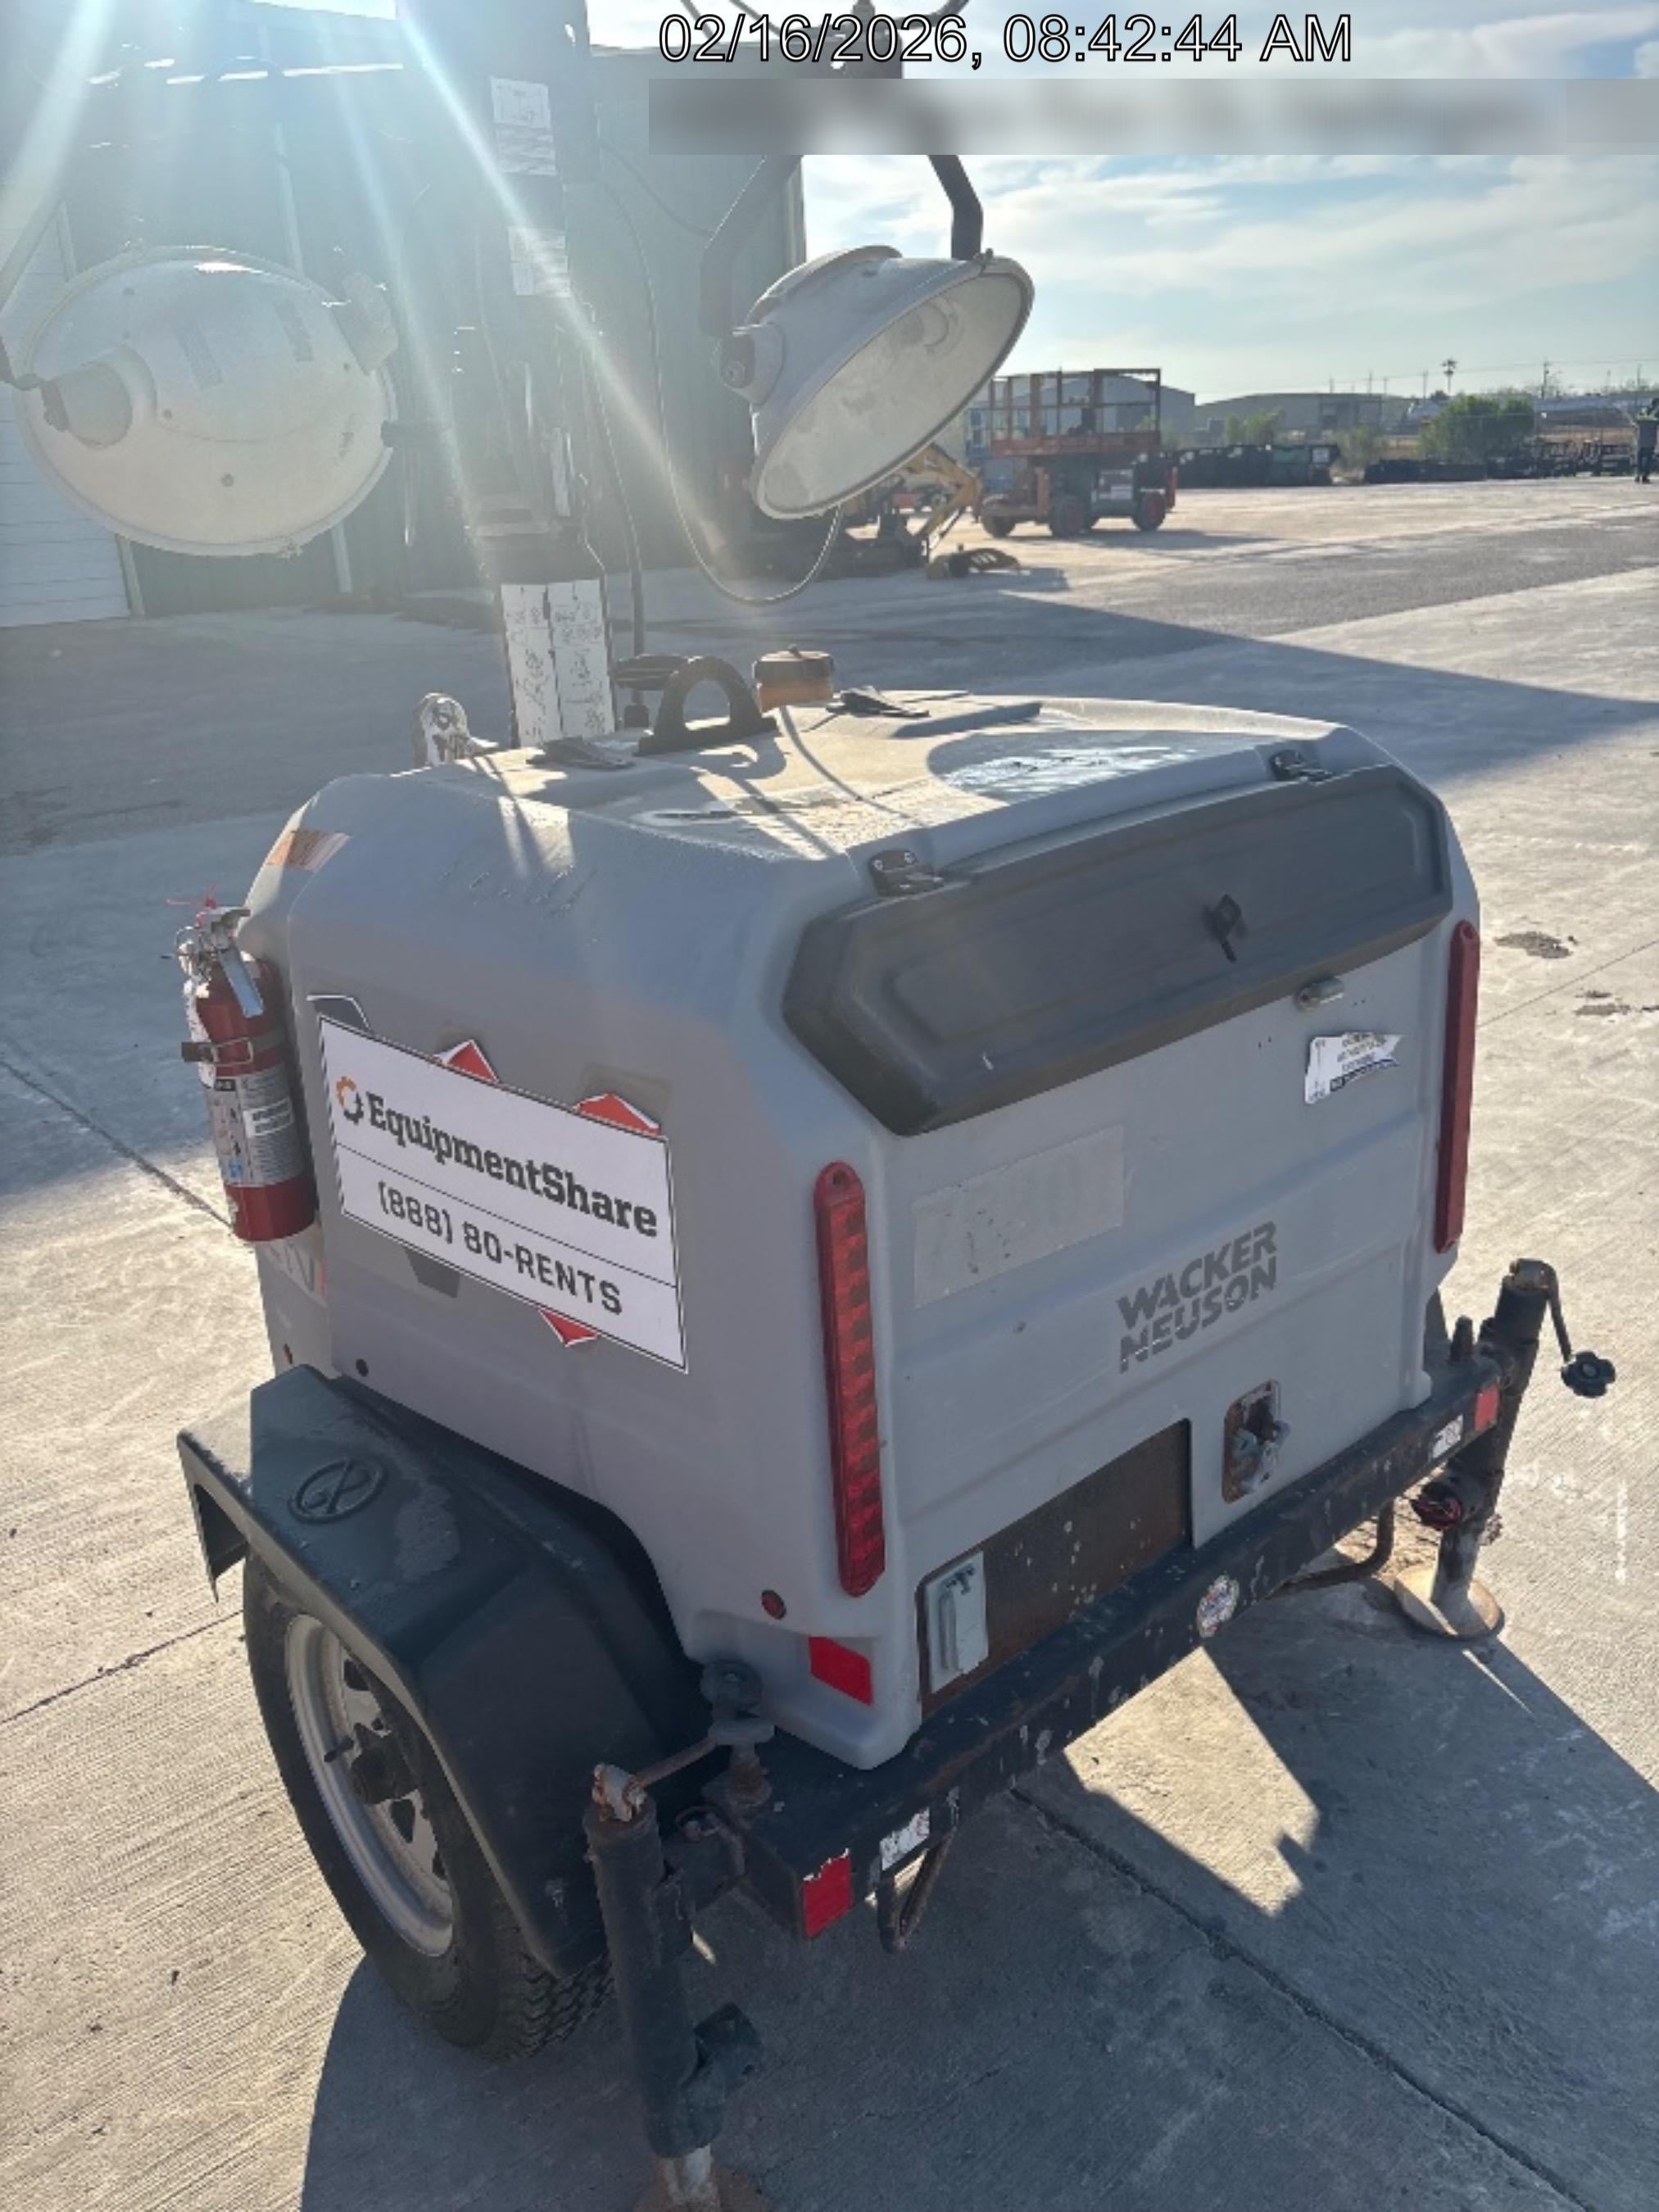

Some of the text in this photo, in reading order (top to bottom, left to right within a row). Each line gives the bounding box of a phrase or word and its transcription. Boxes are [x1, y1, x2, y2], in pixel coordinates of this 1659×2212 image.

[366, 1090, 658, 1237] EquipmentShare
[378, 1181, 622, 1315] (888) 80-RENTS
[1116, 1220, 1276, 1330] WACKER
[1120, 1255, 1276, 1374] NEUSON
